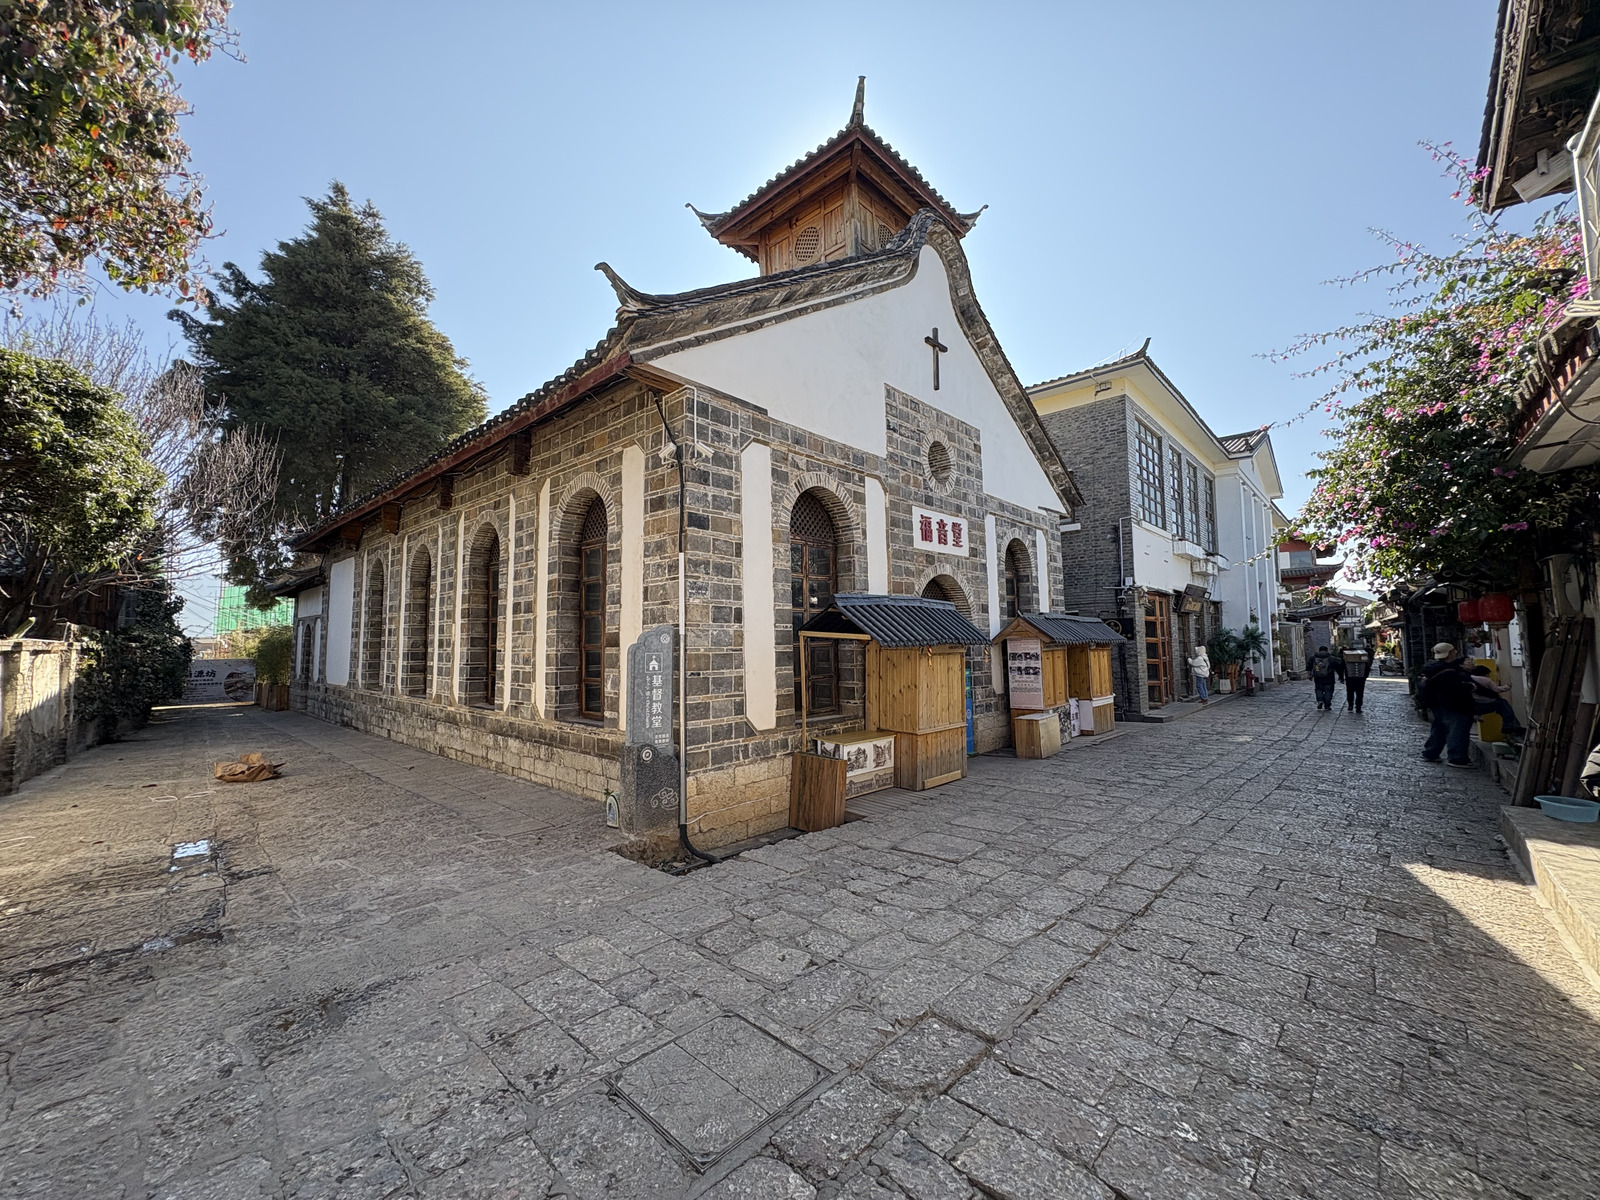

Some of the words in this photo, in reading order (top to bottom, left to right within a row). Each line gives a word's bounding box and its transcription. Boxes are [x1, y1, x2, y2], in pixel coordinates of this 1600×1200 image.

[919, 514, 964, 548] 福音堂
[651, 674, 663, 728] 基督教堂
